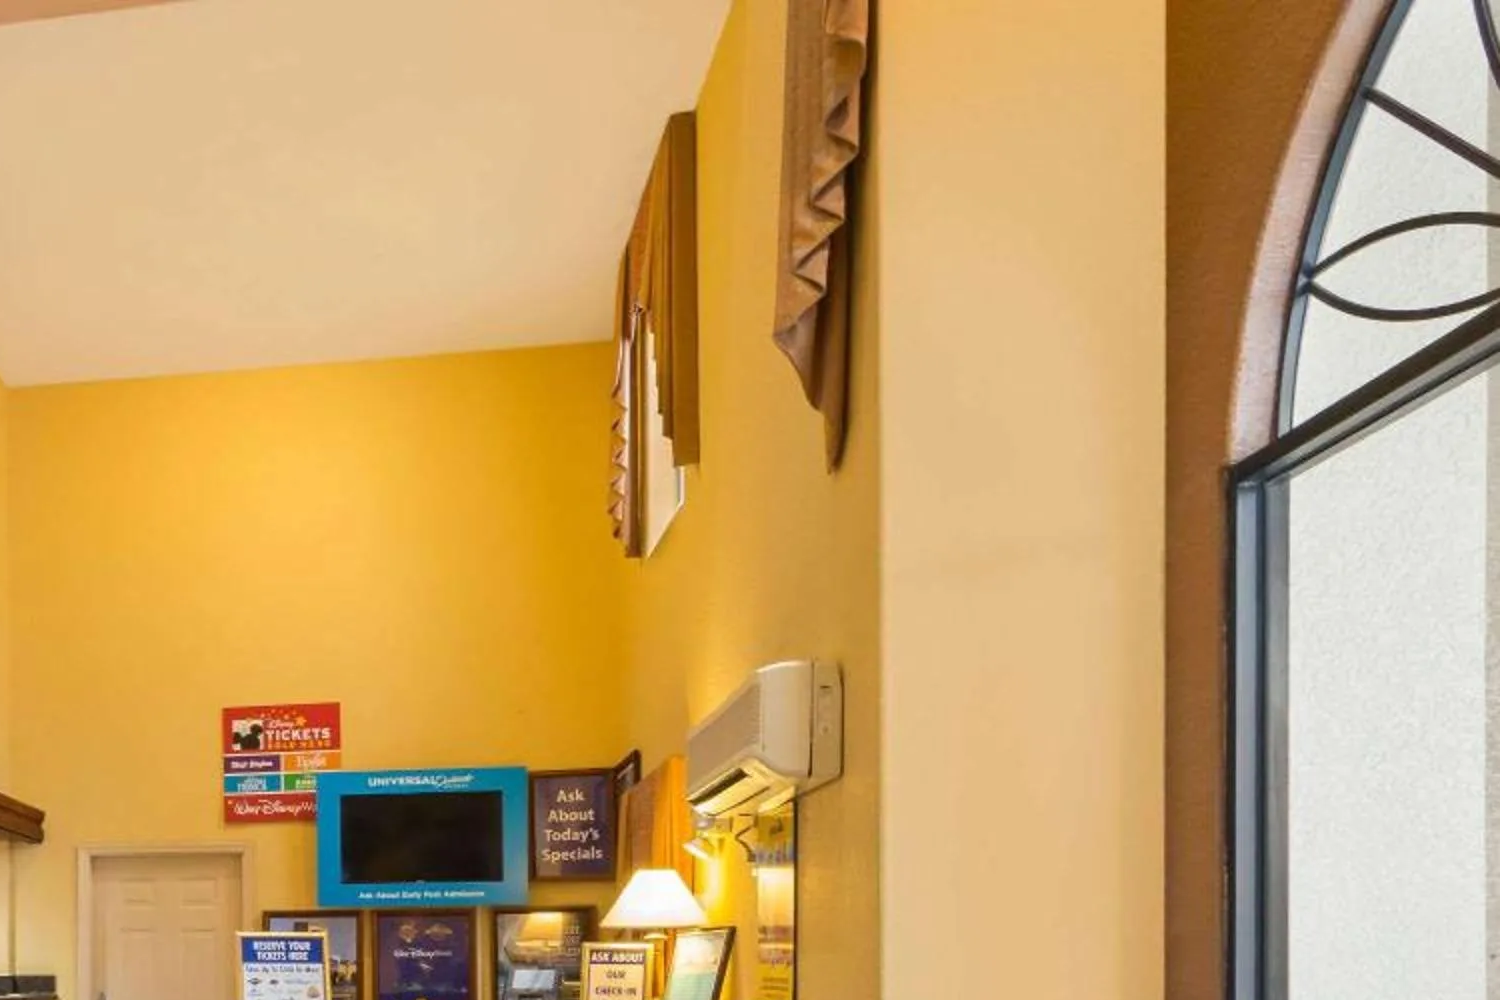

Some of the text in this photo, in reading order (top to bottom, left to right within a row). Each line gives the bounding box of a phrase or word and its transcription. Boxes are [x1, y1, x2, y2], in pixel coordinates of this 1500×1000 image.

[266, 727, 331, 741] TICKETS
[368, 775, 437, 788] UNIVERSAL
[556, 788, 585, 803] Ask
[547, 808, 595, 823] About
[544, 827, 600, 843] Today's
[541, 845, 603, 864] Specials
[253, 940, 311, 951] RESERVE YOUR
[257, 951, 286, 960] TICKETS
[591, 951, 644, 963] ASK ABOUT
[605, 970, 626, 980] OUR
[595, 986, 637, 996] CHECK-IN
